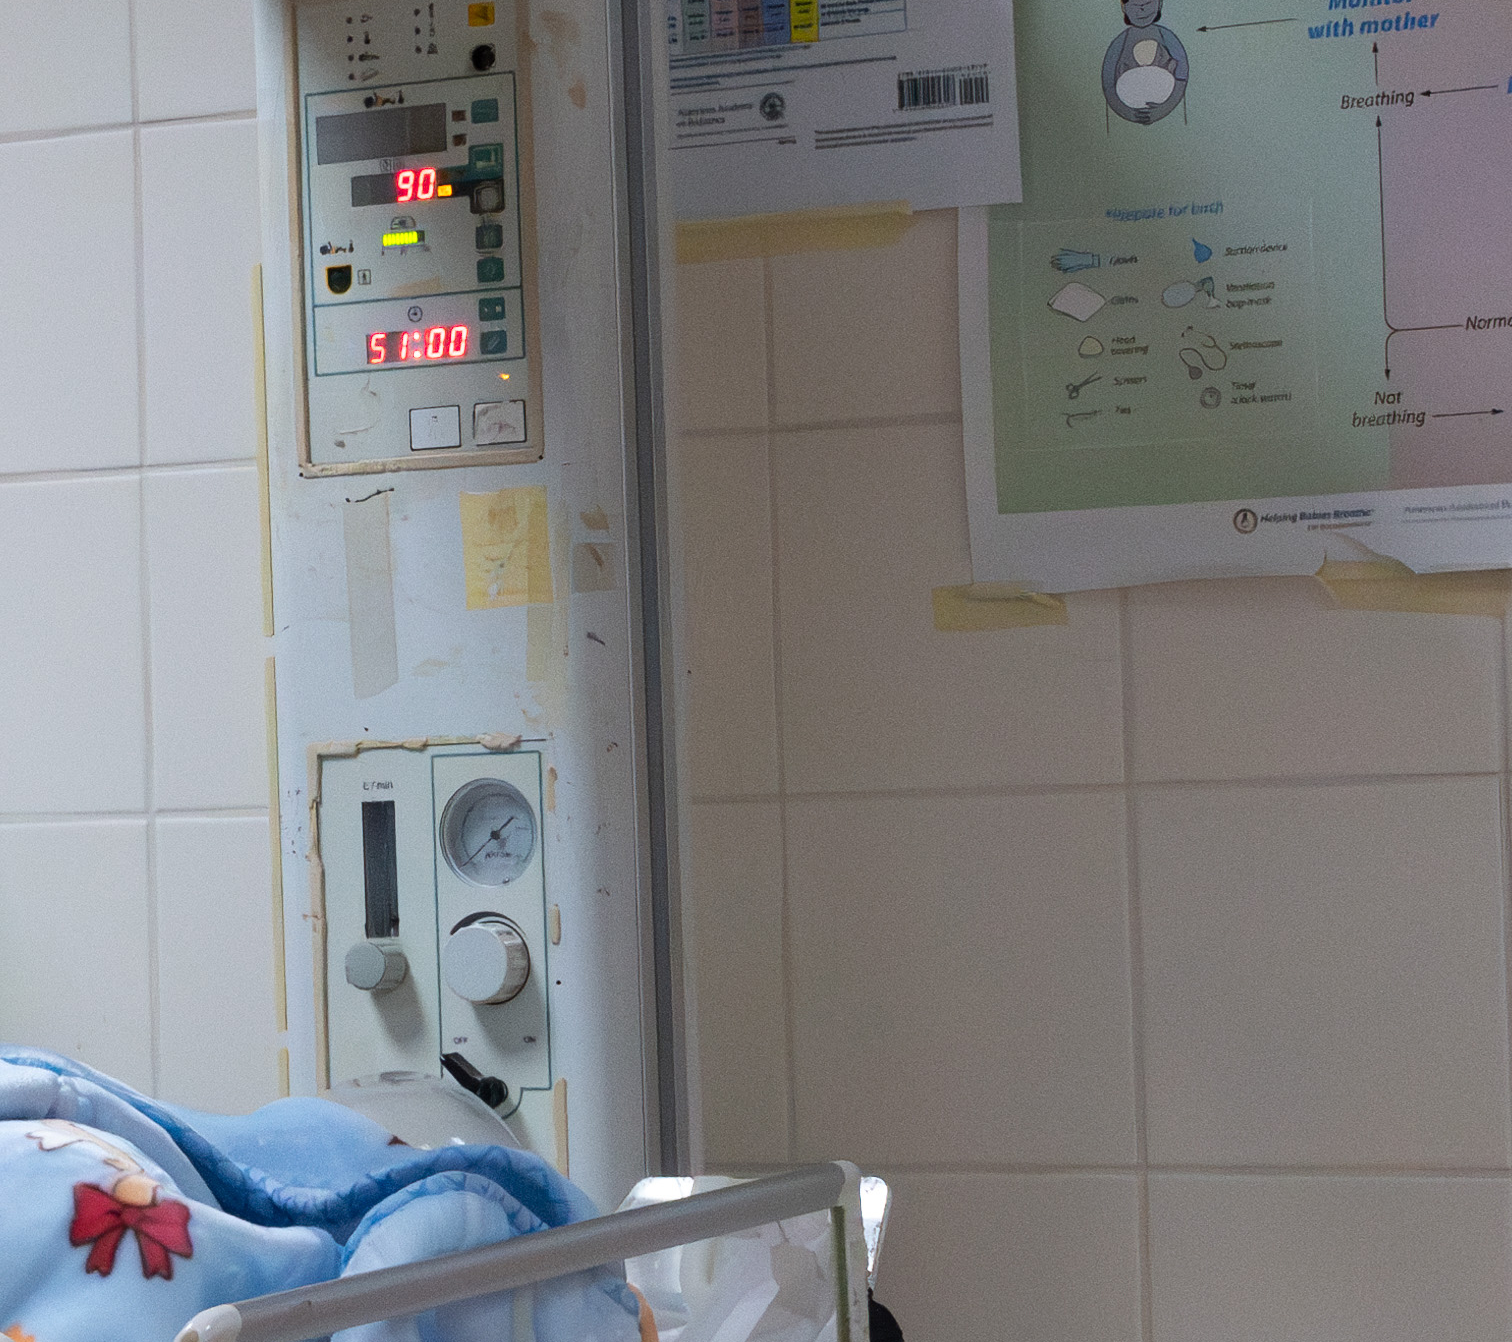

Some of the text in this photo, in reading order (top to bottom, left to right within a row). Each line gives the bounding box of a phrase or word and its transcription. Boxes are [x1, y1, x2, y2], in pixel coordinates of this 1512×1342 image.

[1307, 10, 1440, 40] with mother
[1340, 89, 1415, 110] Breathing
[396, 167, 437, 203] 90
[1168, 204, 1189, 218] for
[1190, 200, 1224, 215] birth
[1374, 391, 1403, 405] Not
[1351, 408, 1427, 428] breathing
